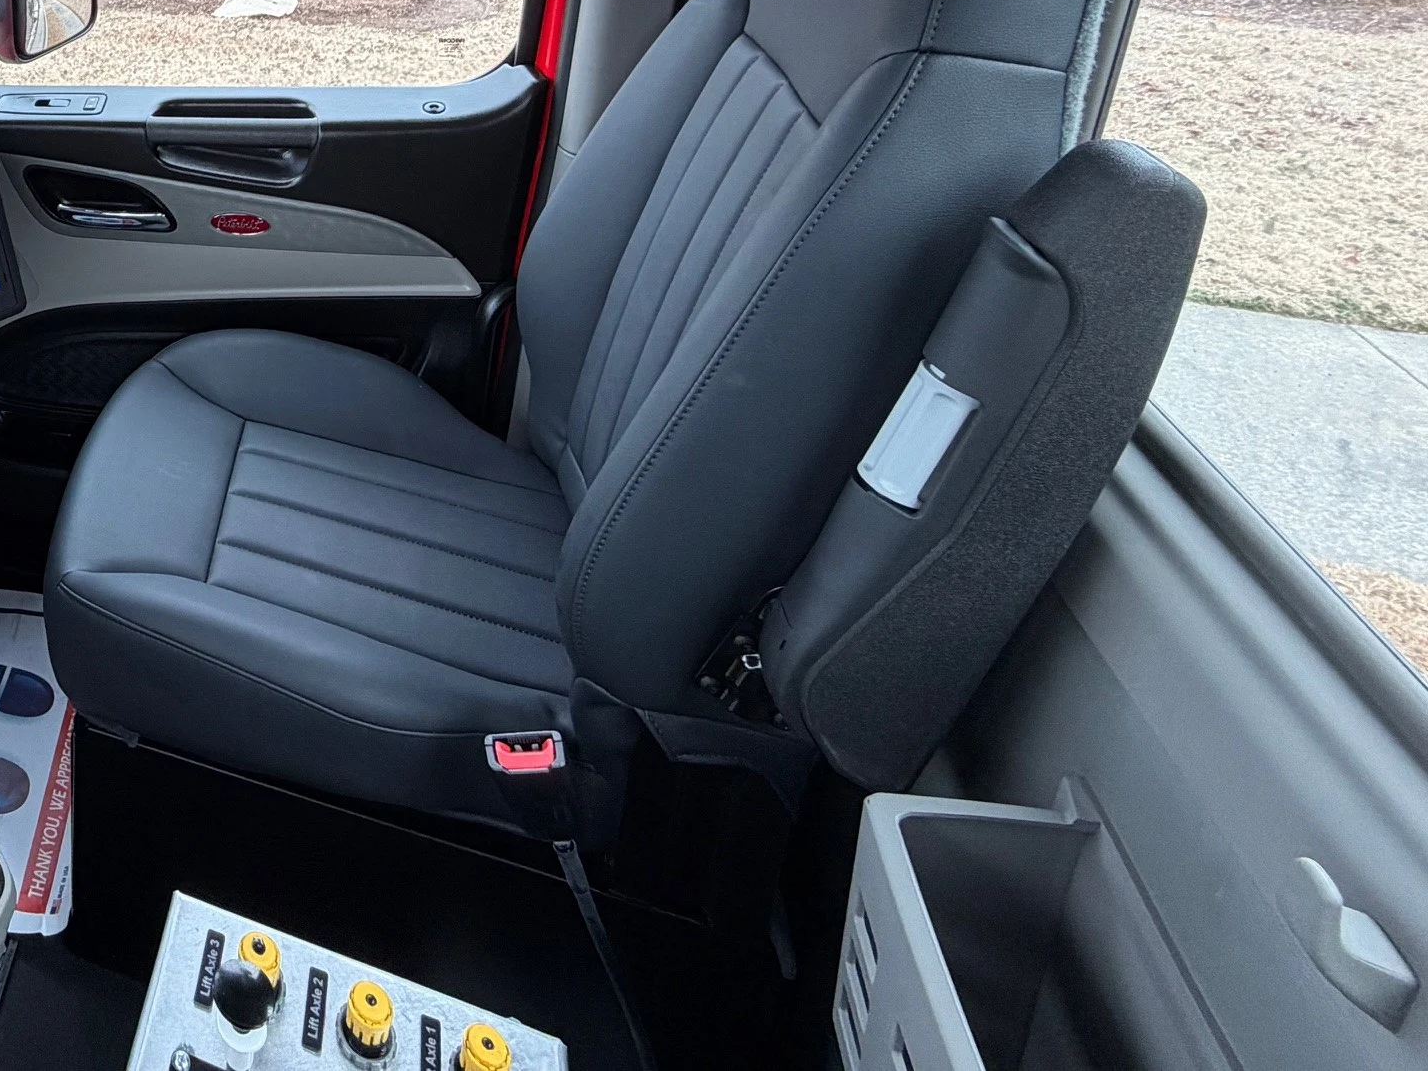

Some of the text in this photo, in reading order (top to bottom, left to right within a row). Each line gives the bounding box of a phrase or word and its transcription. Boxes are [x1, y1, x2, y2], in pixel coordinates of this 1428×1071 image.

[49, 789, 67, 811] WE
[41, 815, 63, 846] YOU,
[27, 848, 54, 898] THANK
[200, 939, 220, 997] Lift Axle 3
[307, 977, 323, 1039] Lift Axle 2
[425, 1026, 437, 1034] 1
[425, 1037, 437, 1068] Axle
